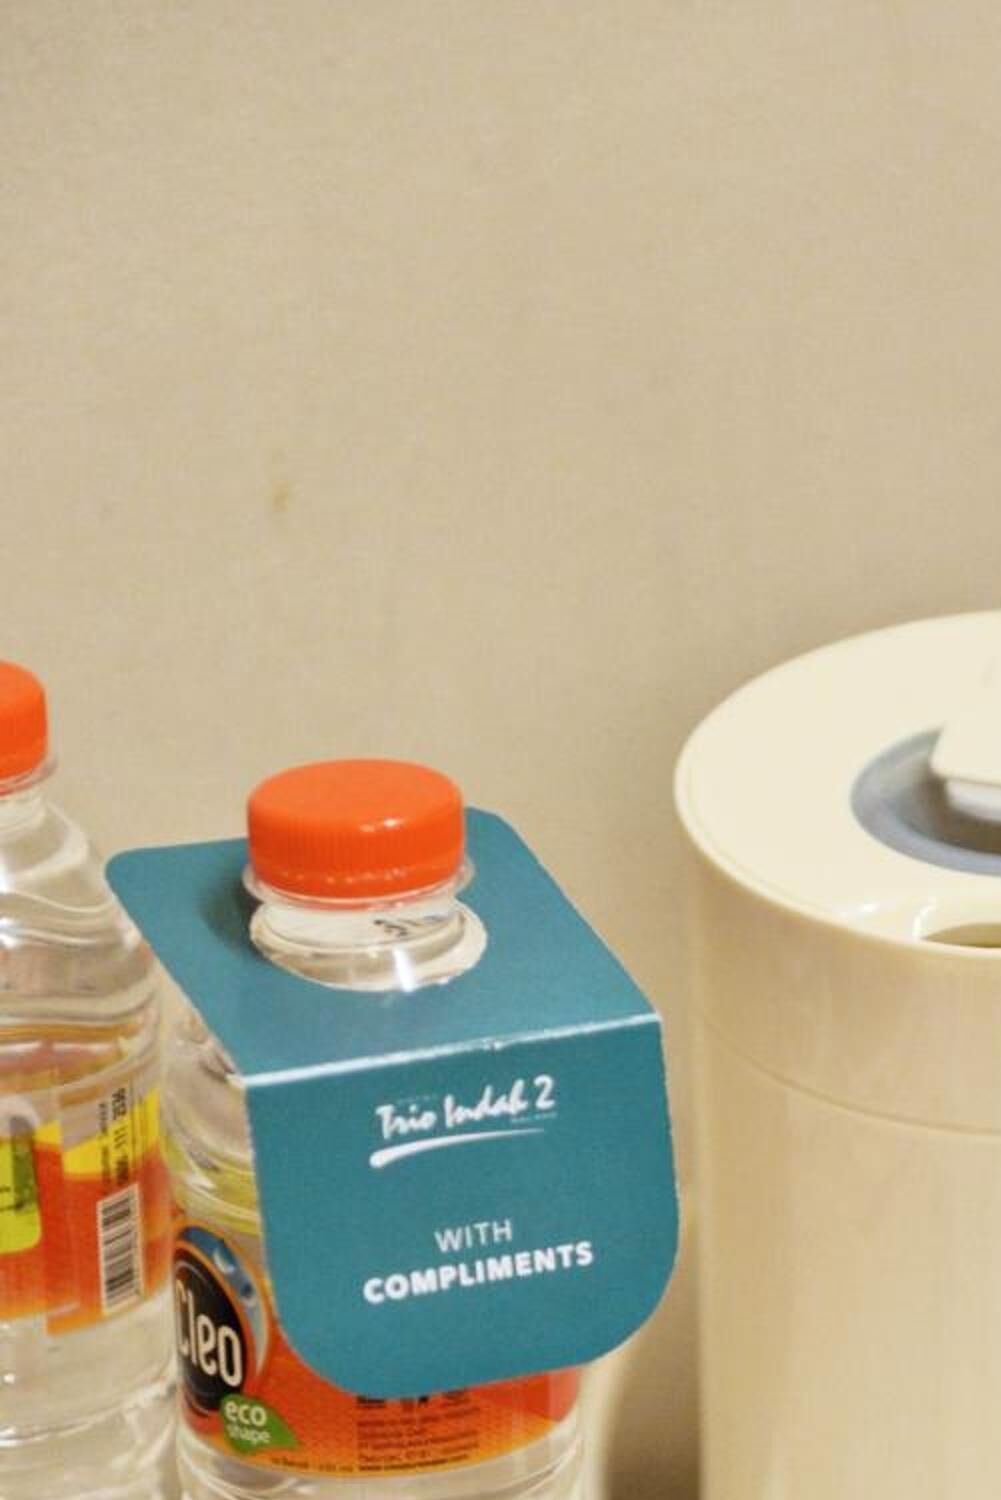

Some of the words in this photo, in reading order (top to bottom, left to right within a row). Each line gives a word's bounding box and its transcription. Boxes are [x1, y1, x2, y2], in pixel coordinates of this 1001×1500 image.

[375, 1102, 437, 1140] Trio
[444, 1078, 529, 1129] Indah
[533, 1073, 556, 1110] 2
[433, 1218, 514, 1254] WITH
[362, 1240, 595, 1305] COMPLIMENTS
[175, 1278, 243, 1388] Cleo
[223, 1400, 268, 1427] eco
